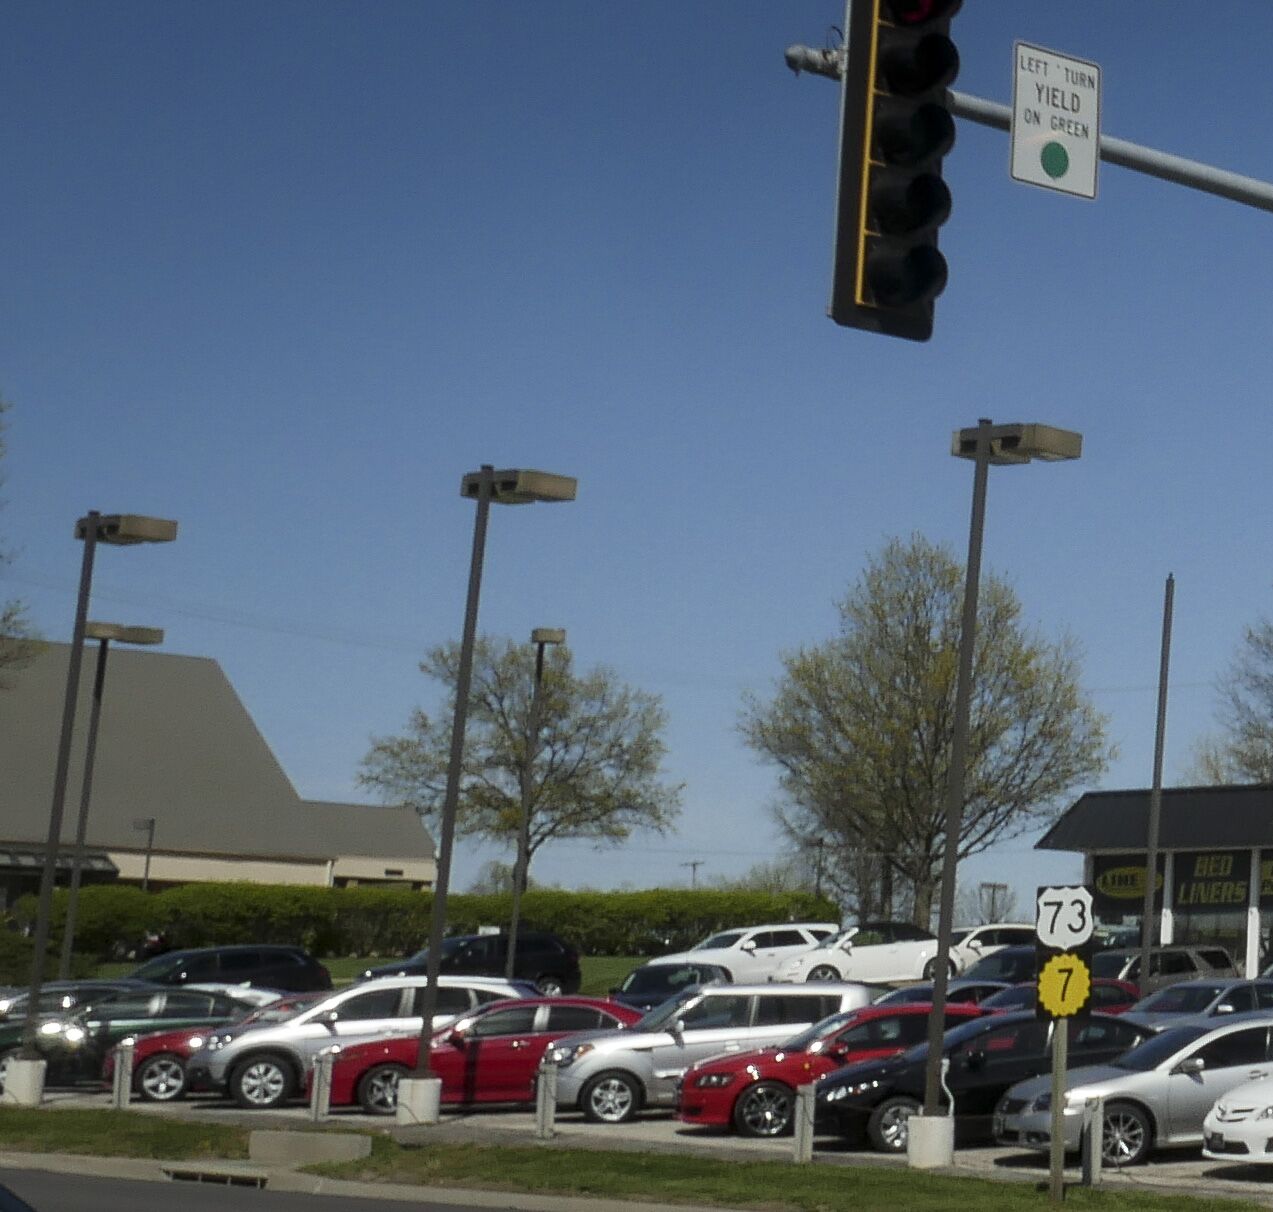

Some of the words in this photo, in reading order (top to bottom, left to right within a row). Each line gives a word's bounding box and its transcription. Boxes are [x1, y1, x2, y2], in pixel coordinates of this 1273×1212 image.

[1020, 55, 1049, 77] LEFT
[1064, 67, 1096, 90] TURN
[1035, 82, 1081, 114] YIELD
[1024, 108, 1041, 126] ON
[1051, 115, 1090, 139] GREEN
[1178, 880, 1248, 905] LINERS
[1043, 899, 1086, 935] 73
[1057, 967, 1074, 1003] 7
